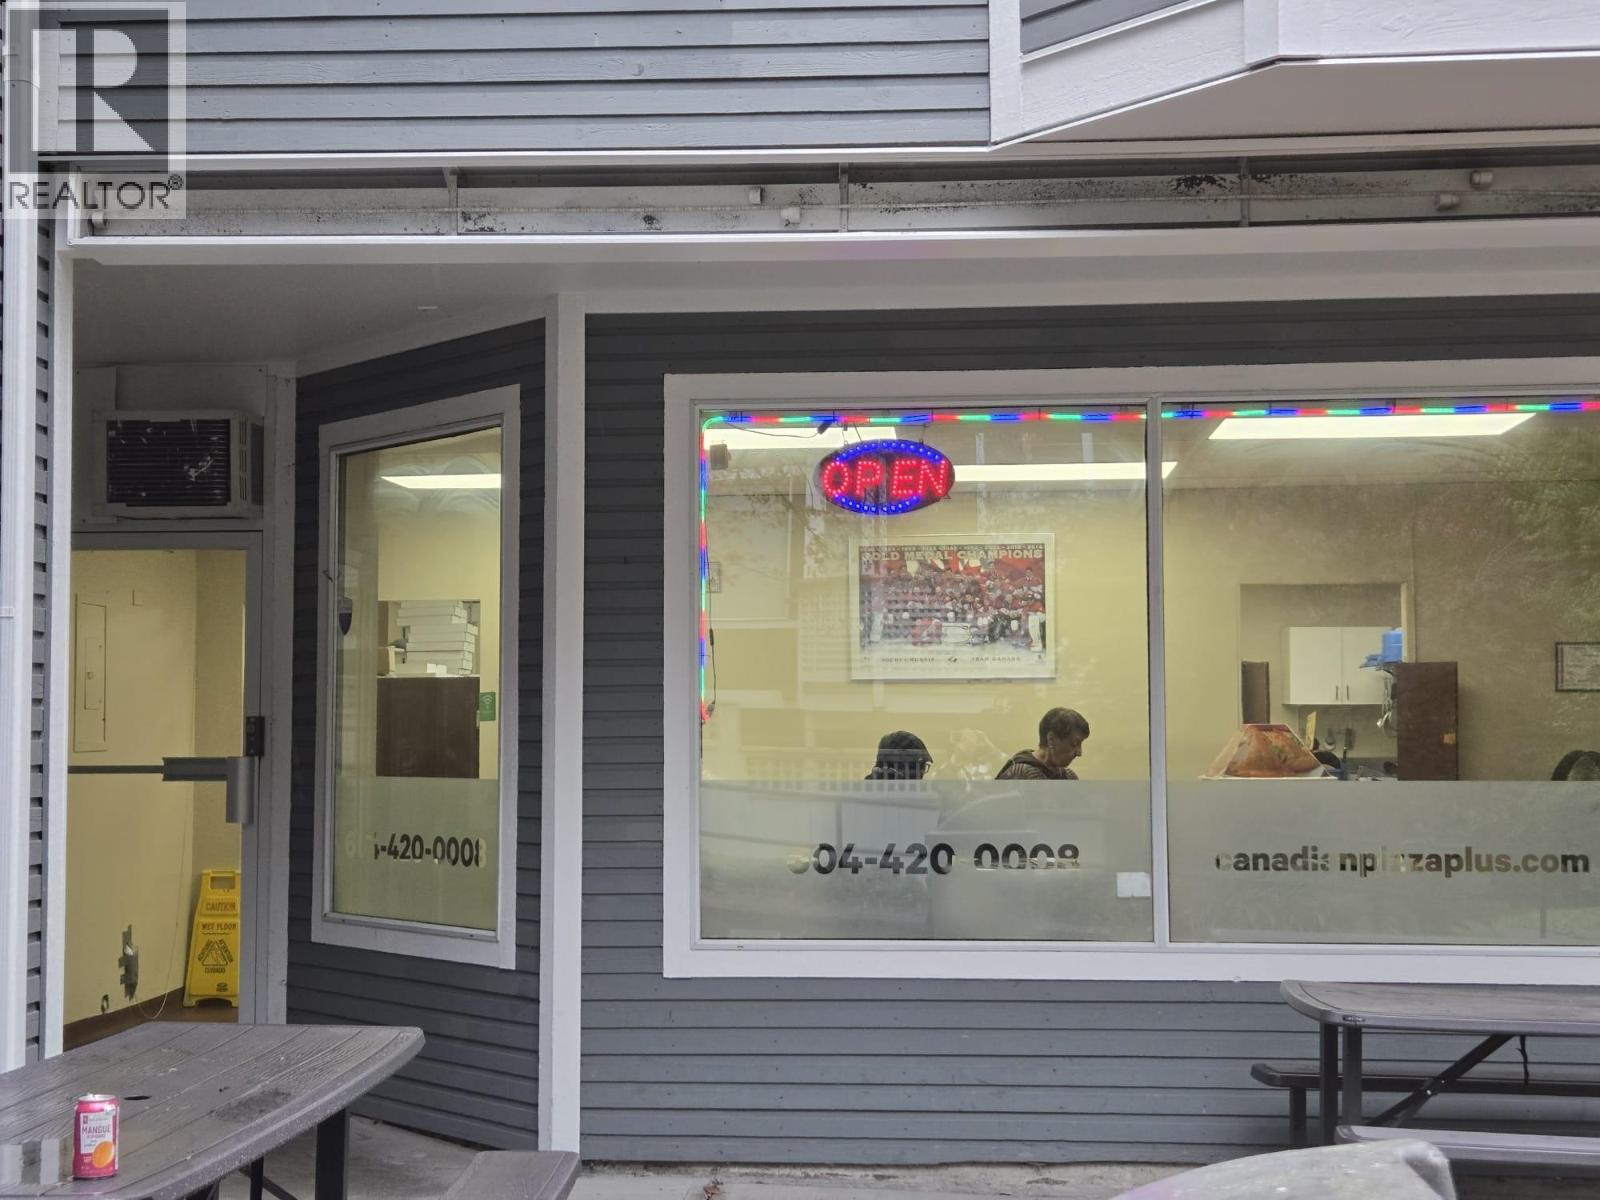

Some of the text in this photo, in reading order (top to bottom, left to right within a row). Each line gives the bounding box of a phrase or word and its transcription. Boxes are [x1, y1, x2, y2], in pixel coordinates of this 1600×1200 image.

[822, 458, 948, 498] OPEN
[861, 549, 1043, 561] GOLD MEDAL CHAMPIONS
